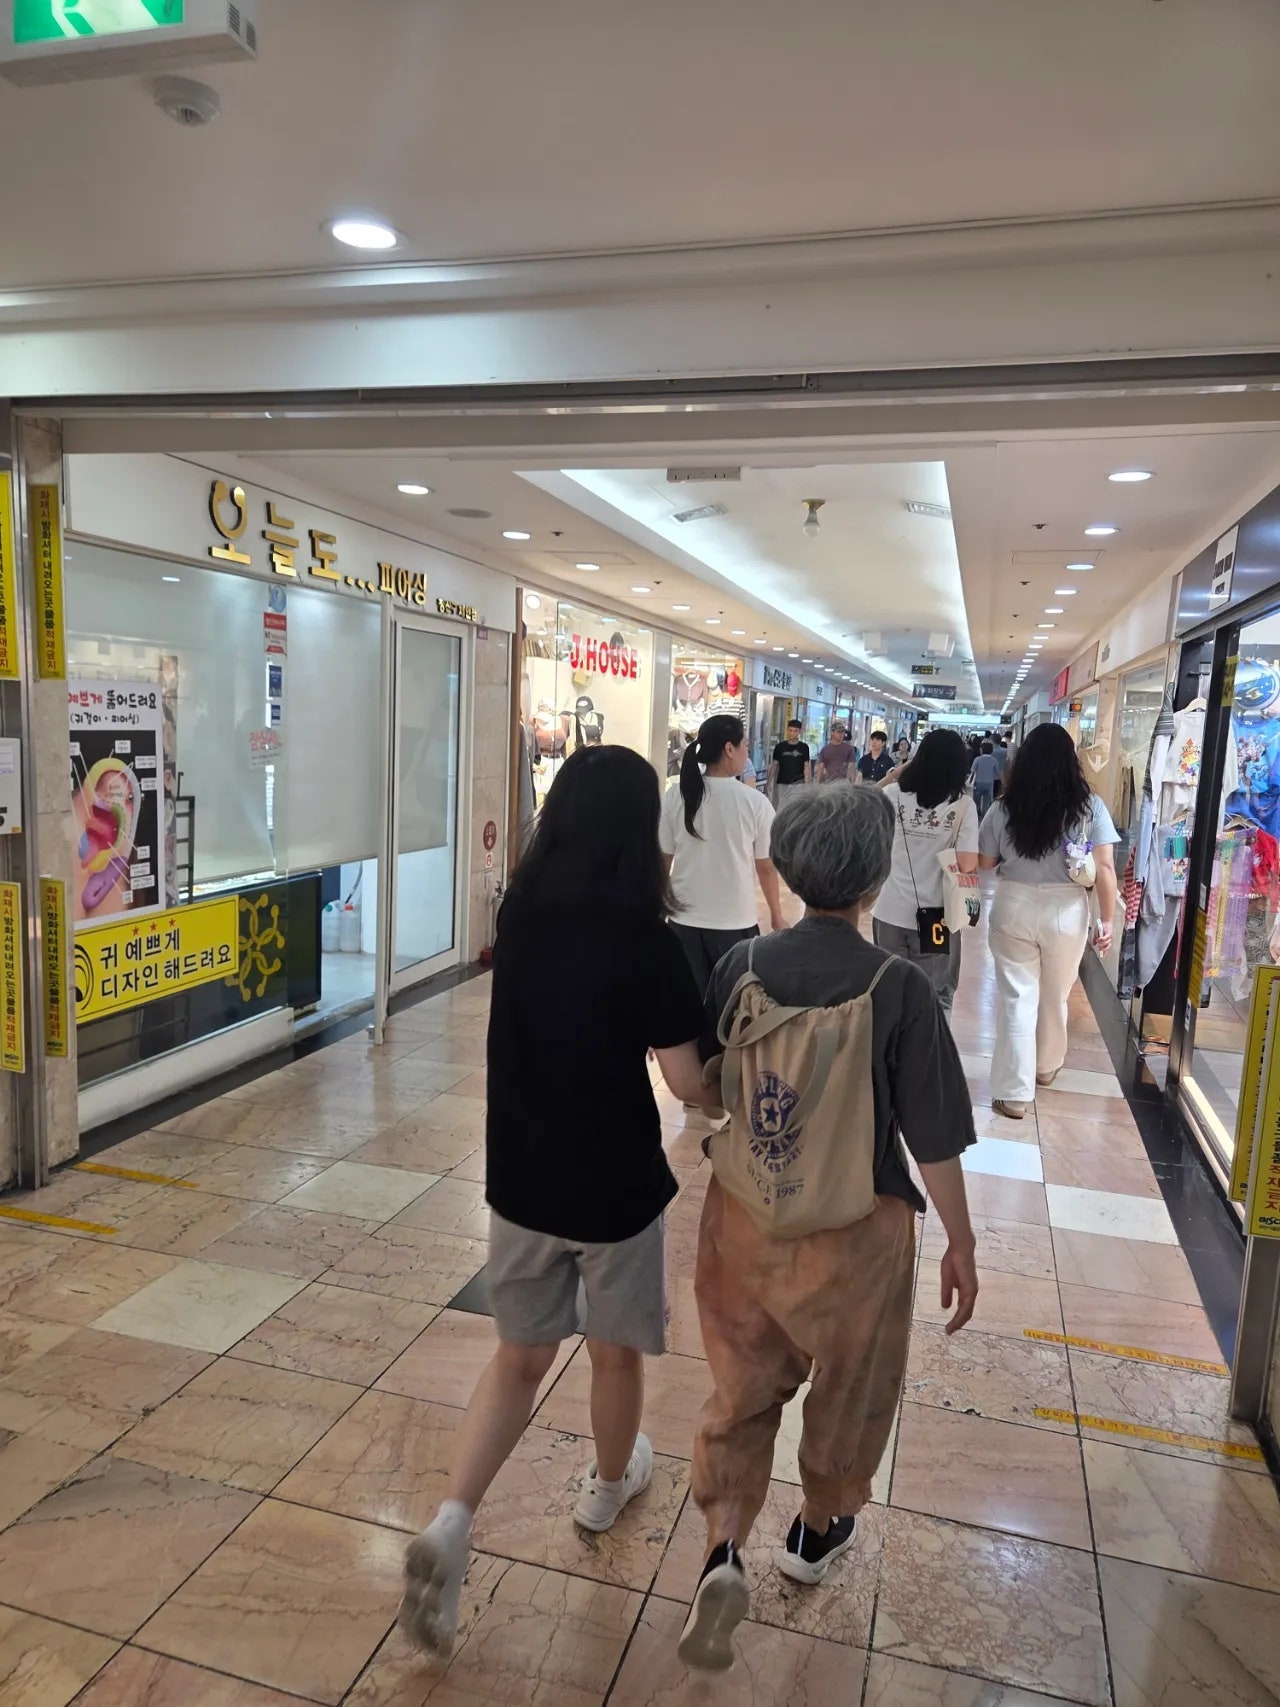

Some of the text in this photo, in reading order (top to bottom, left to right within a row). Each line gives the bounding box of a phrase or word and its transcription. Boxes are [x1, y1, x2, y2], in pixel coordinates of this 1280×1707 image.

[377, 562, 428, 606] 피어싱
[569, 633, 638, 679] J.HOUSE
[106, 689, 157, 710] 뚫어드려요
[100, 928, 180, 970] 귀 예쁘게
[932, 923, 944, 945] C
[101, 944, 231, 998] 디자인 해드려요
[775, 1183, 804, 1199] 1987
